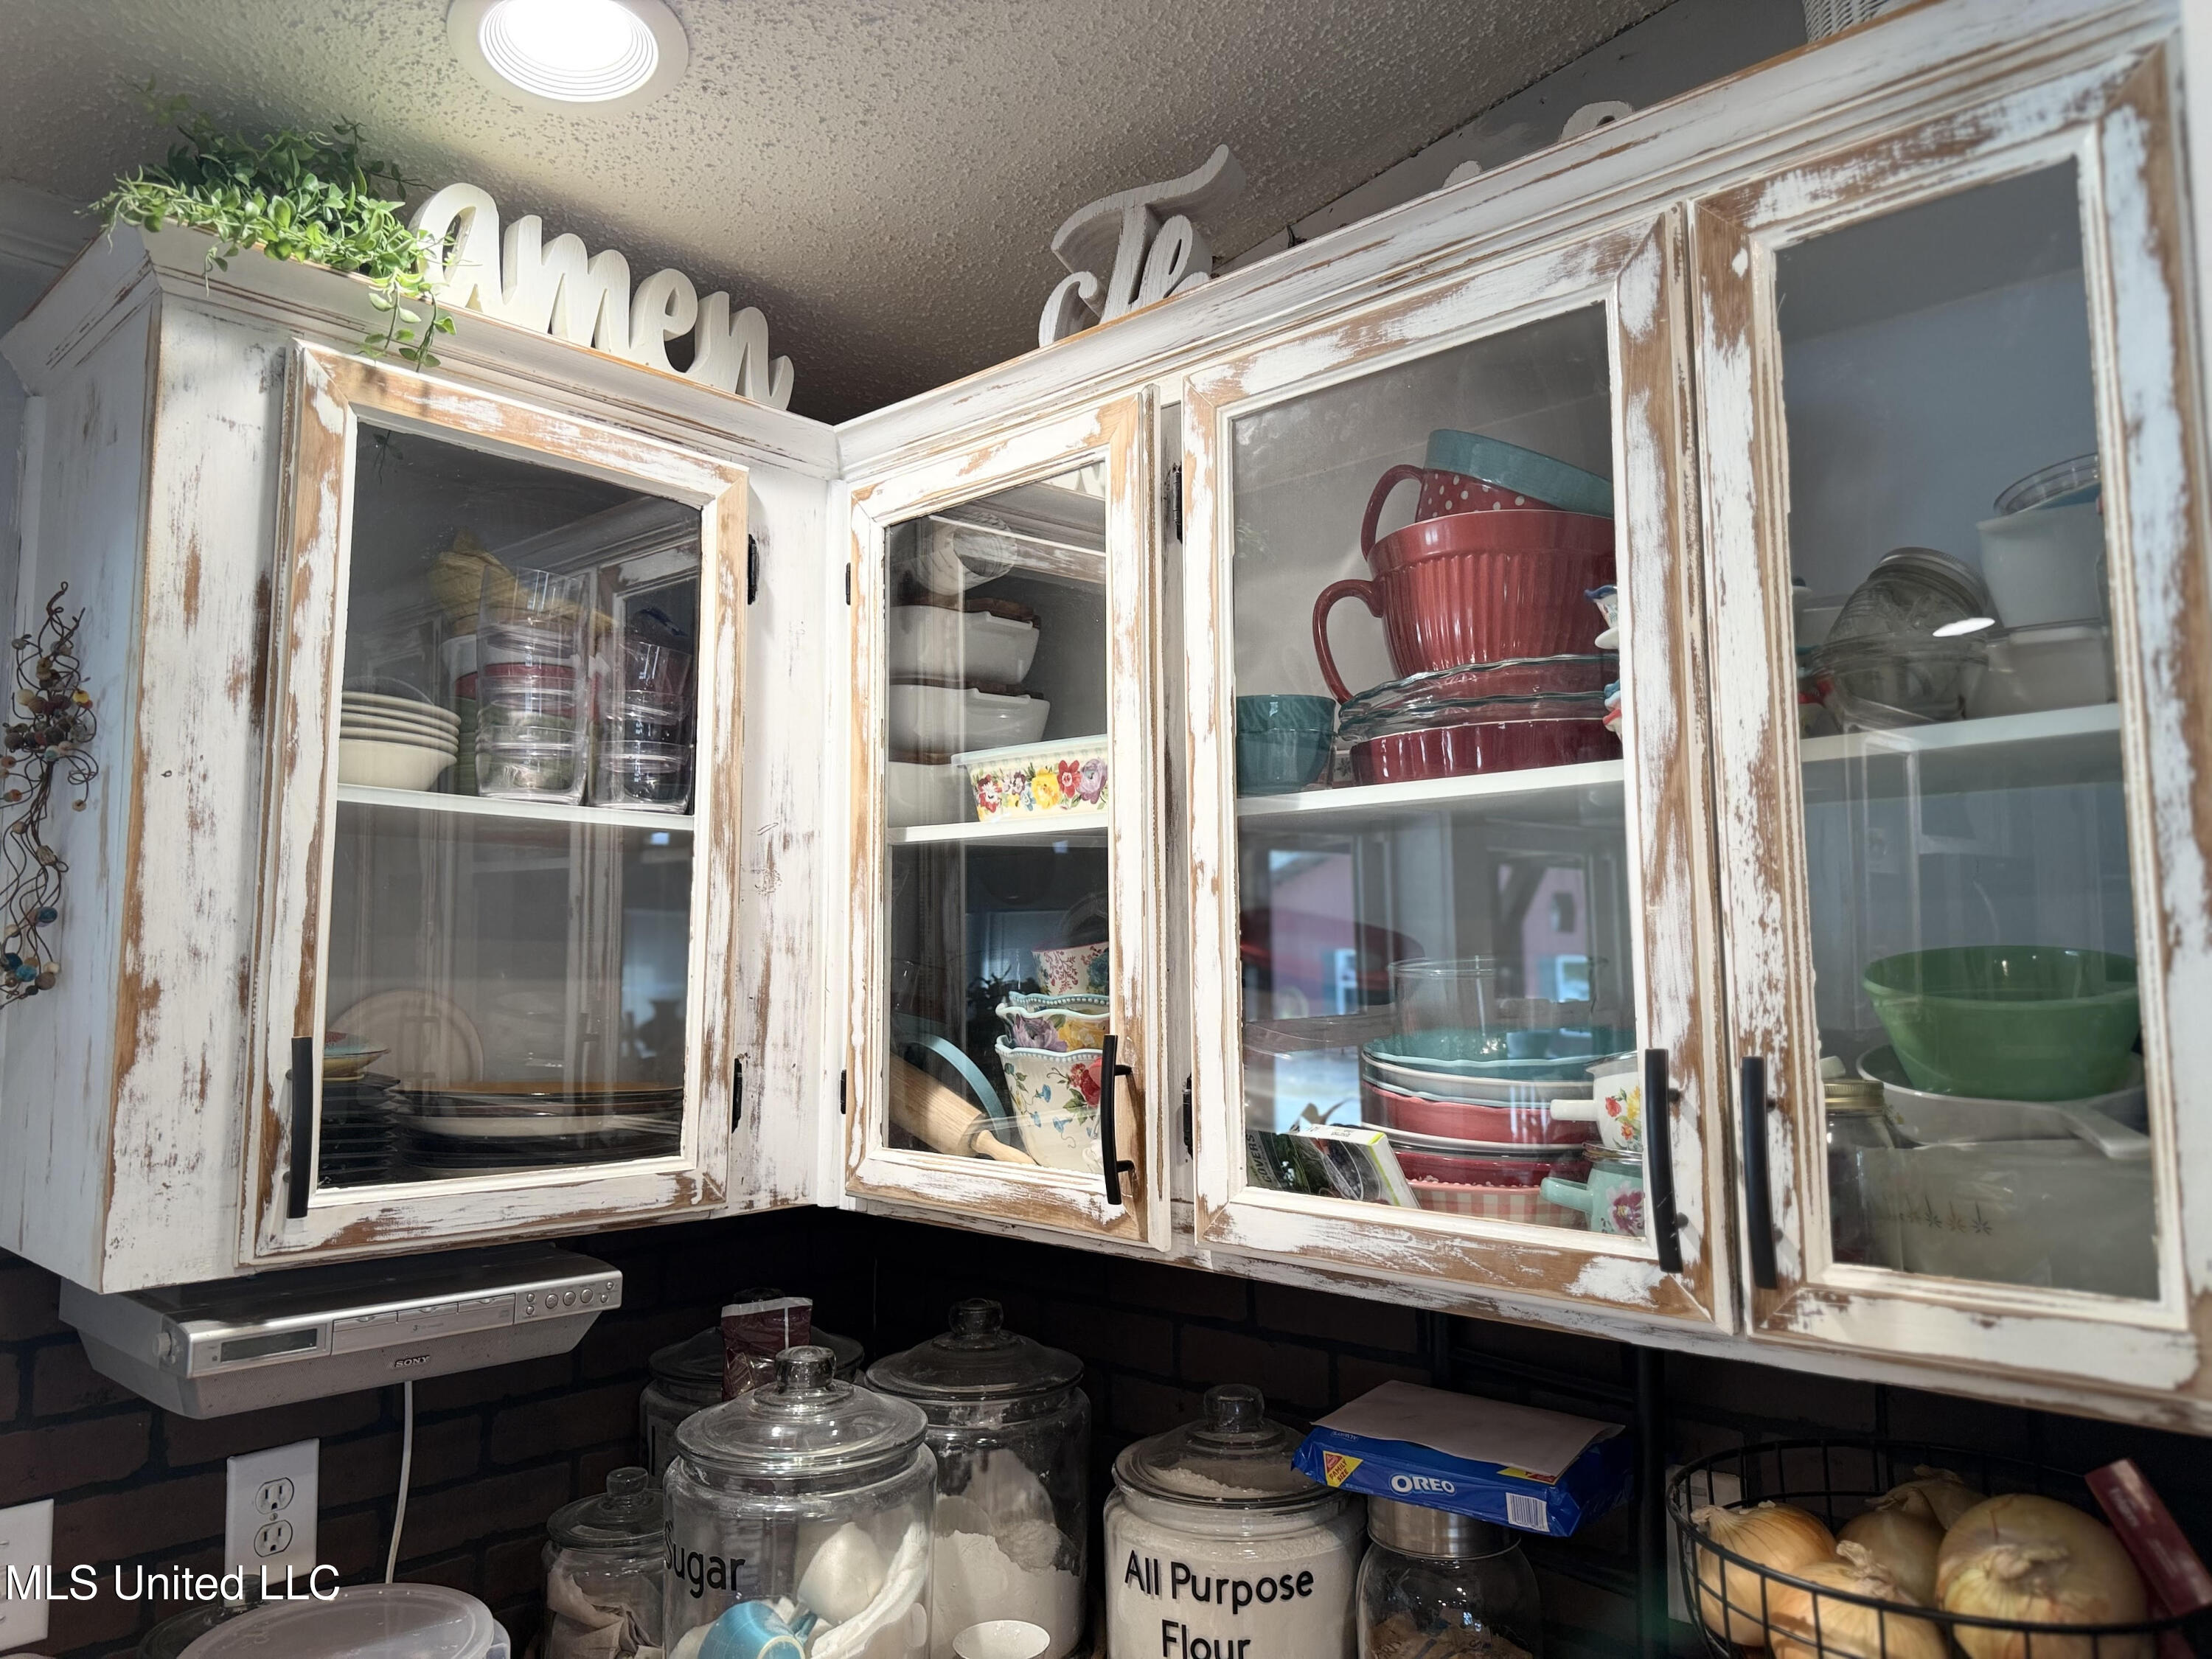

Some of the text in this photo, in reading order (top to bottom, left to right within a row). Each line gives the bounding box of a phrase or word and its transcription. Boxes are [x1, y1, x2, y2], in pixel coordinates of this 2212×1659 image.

[394, 1354, 430, 1368] SONY
[1329, 1458, 1347, 1481] FAMILY
[1390, 1475, 1456, 1494] OREO
[664, 1519, 746, 1599] Sugar
[1124, 1549, 1315, 1615] All Purpose
[1161, 1618, 1251, 1659] Flour
